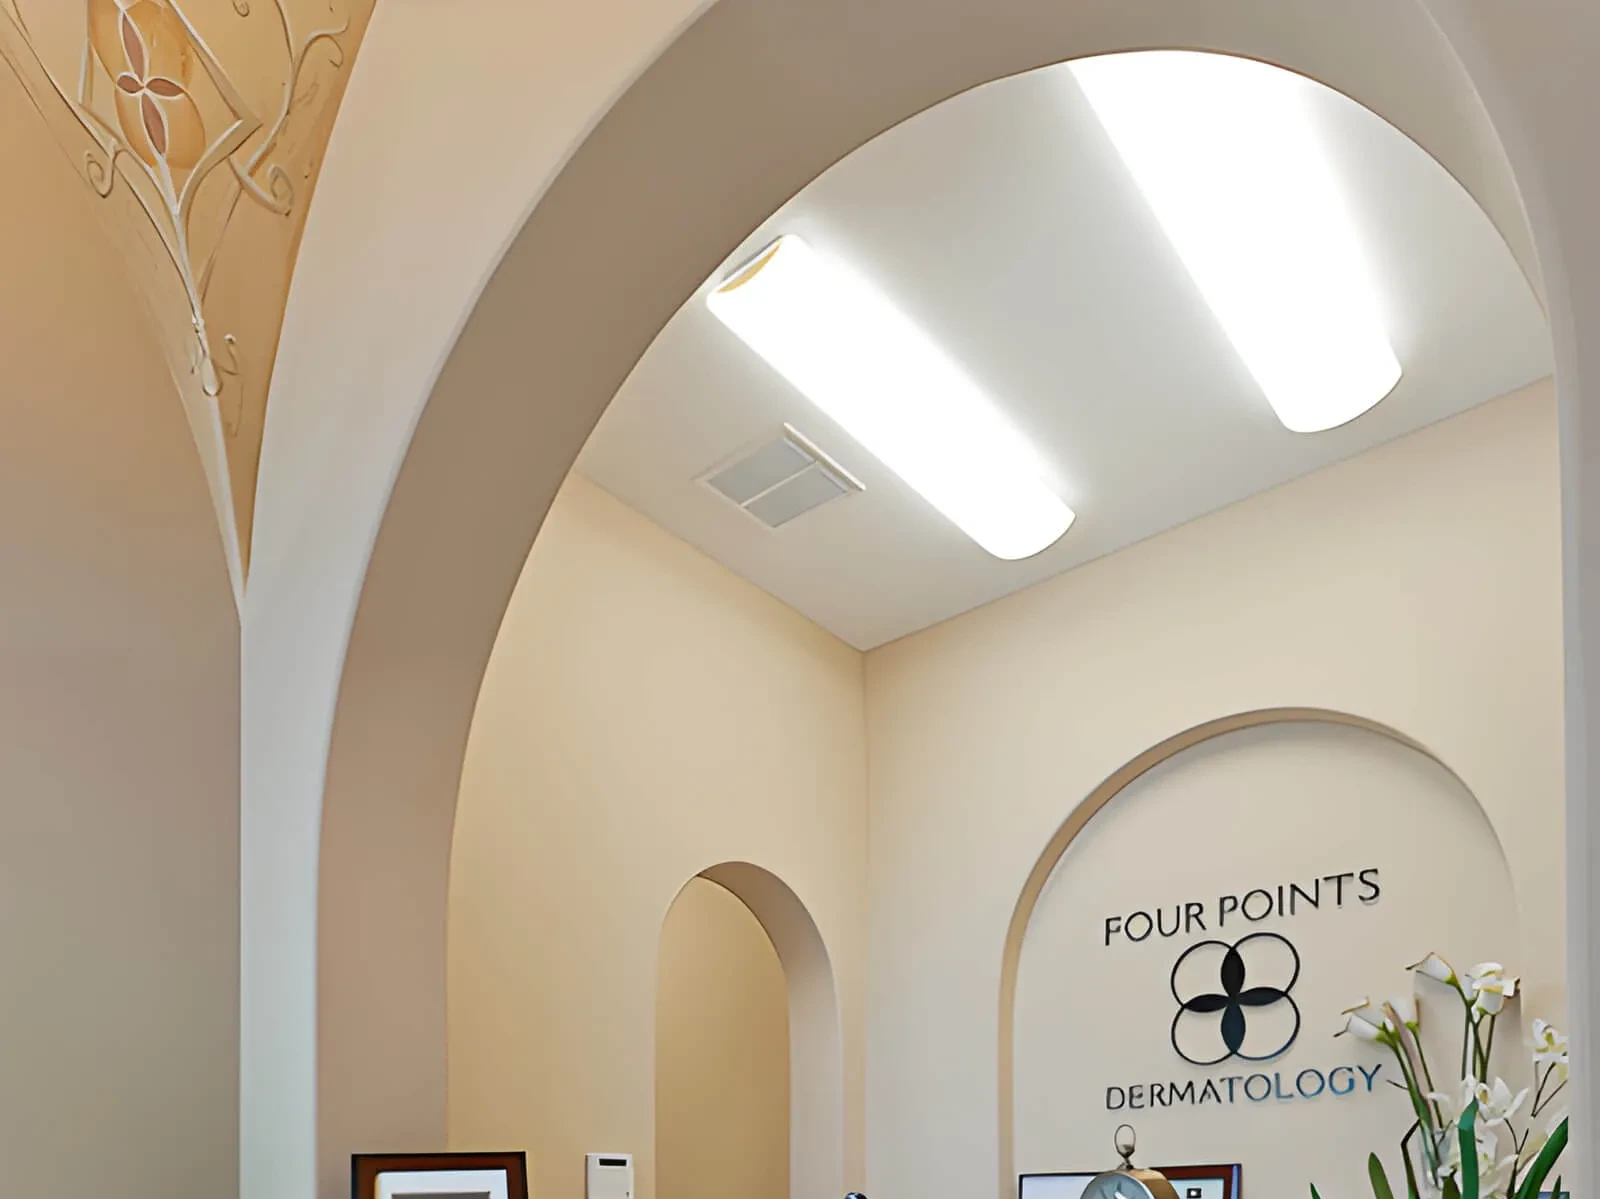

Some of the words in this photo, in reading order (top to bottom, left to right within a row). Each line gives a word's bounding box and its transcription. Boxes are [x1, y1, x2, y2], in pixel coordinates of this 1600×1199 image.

[1104, 902, 1207, 946] FOUR
[1219, 868, 1380, 927] POINTS
[1106, 1064, 1382, 1110] DERMATOLOGY
